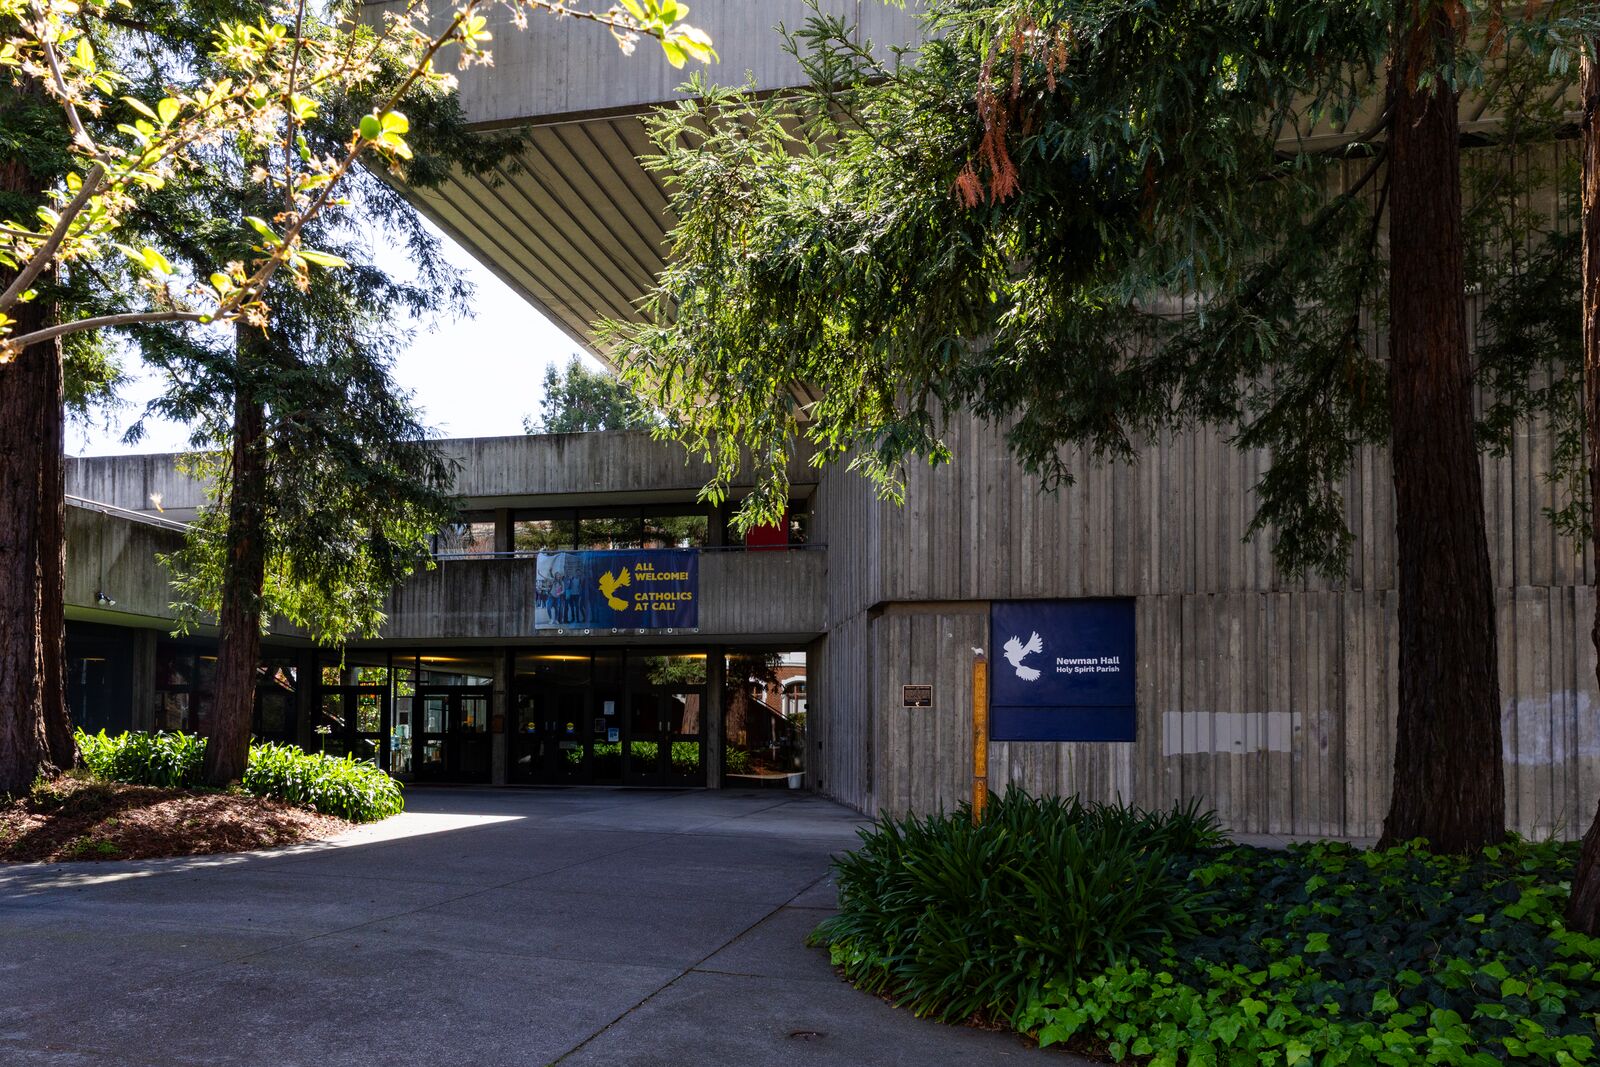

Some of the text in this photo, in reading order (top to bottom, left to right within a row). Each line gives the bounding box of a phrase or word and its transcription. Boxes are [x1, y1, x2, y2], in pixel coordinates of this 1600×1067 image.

[634, 562, 655, 571] ALL
[634, 571, 689, 581] WELCOME!
[634, 592, 693, 601] CATHOLICS
[634, 602, 676, 611] AT CAL!
[1056, 655, 1120, 665] Newman Hall
[1056, 665, 1120, 674] Holy Spirit Parish
